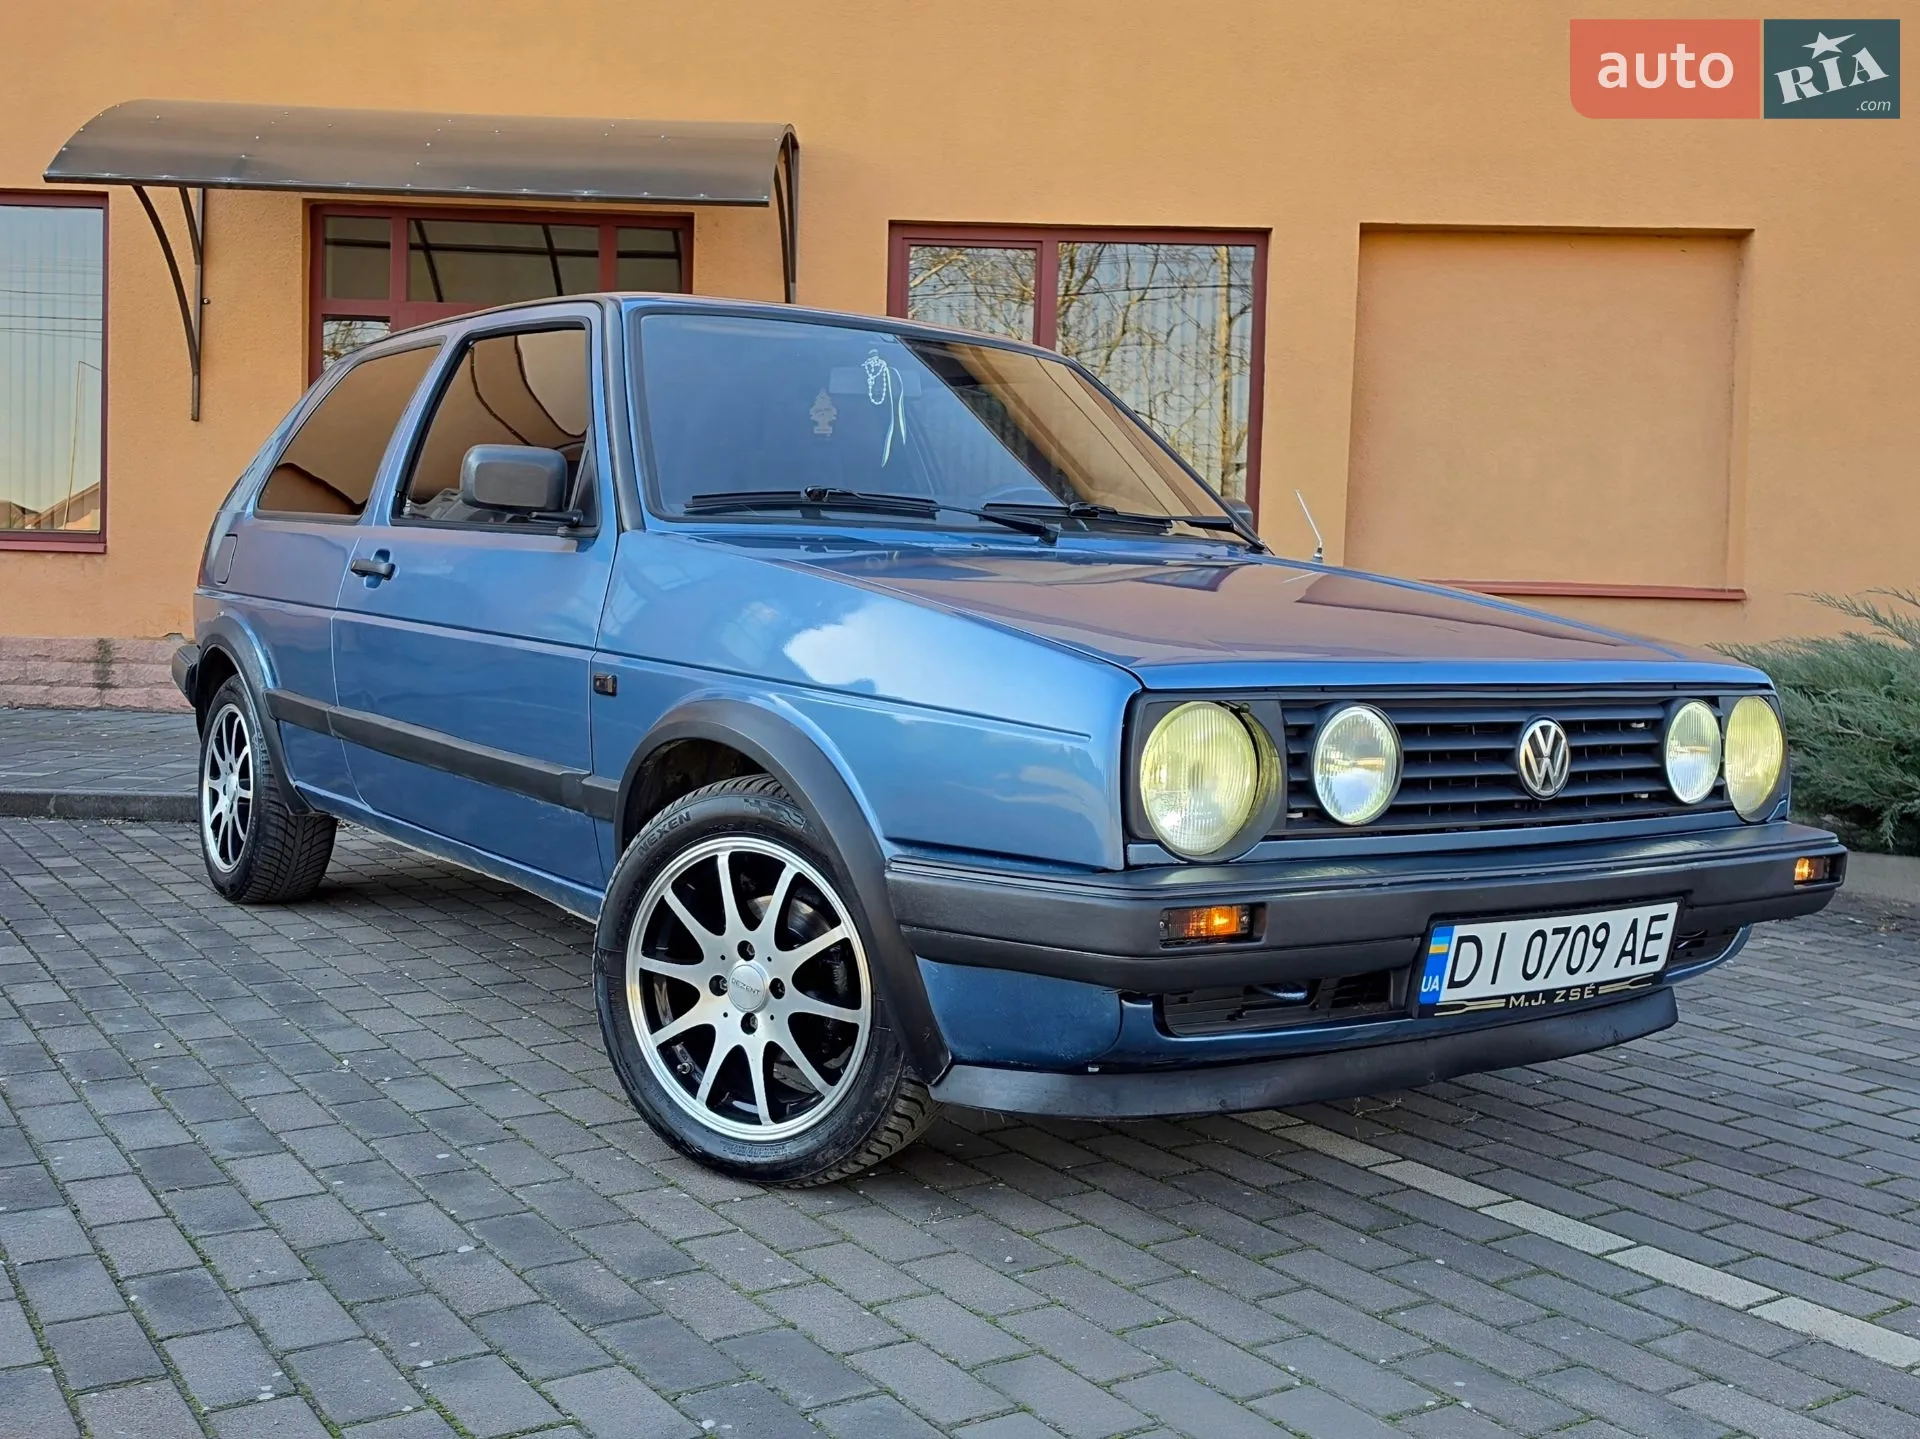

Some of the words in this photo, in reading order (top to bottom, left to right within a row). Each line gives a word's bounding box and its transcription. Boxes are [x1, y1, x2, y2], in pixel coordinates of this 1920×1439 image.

[637, 811, 692, 857] NEXEN
[1521, 921, 1611, 982] 0709
[1614, 912, 1669, 969] AE
[1421, 975, 1440, 993] UA
